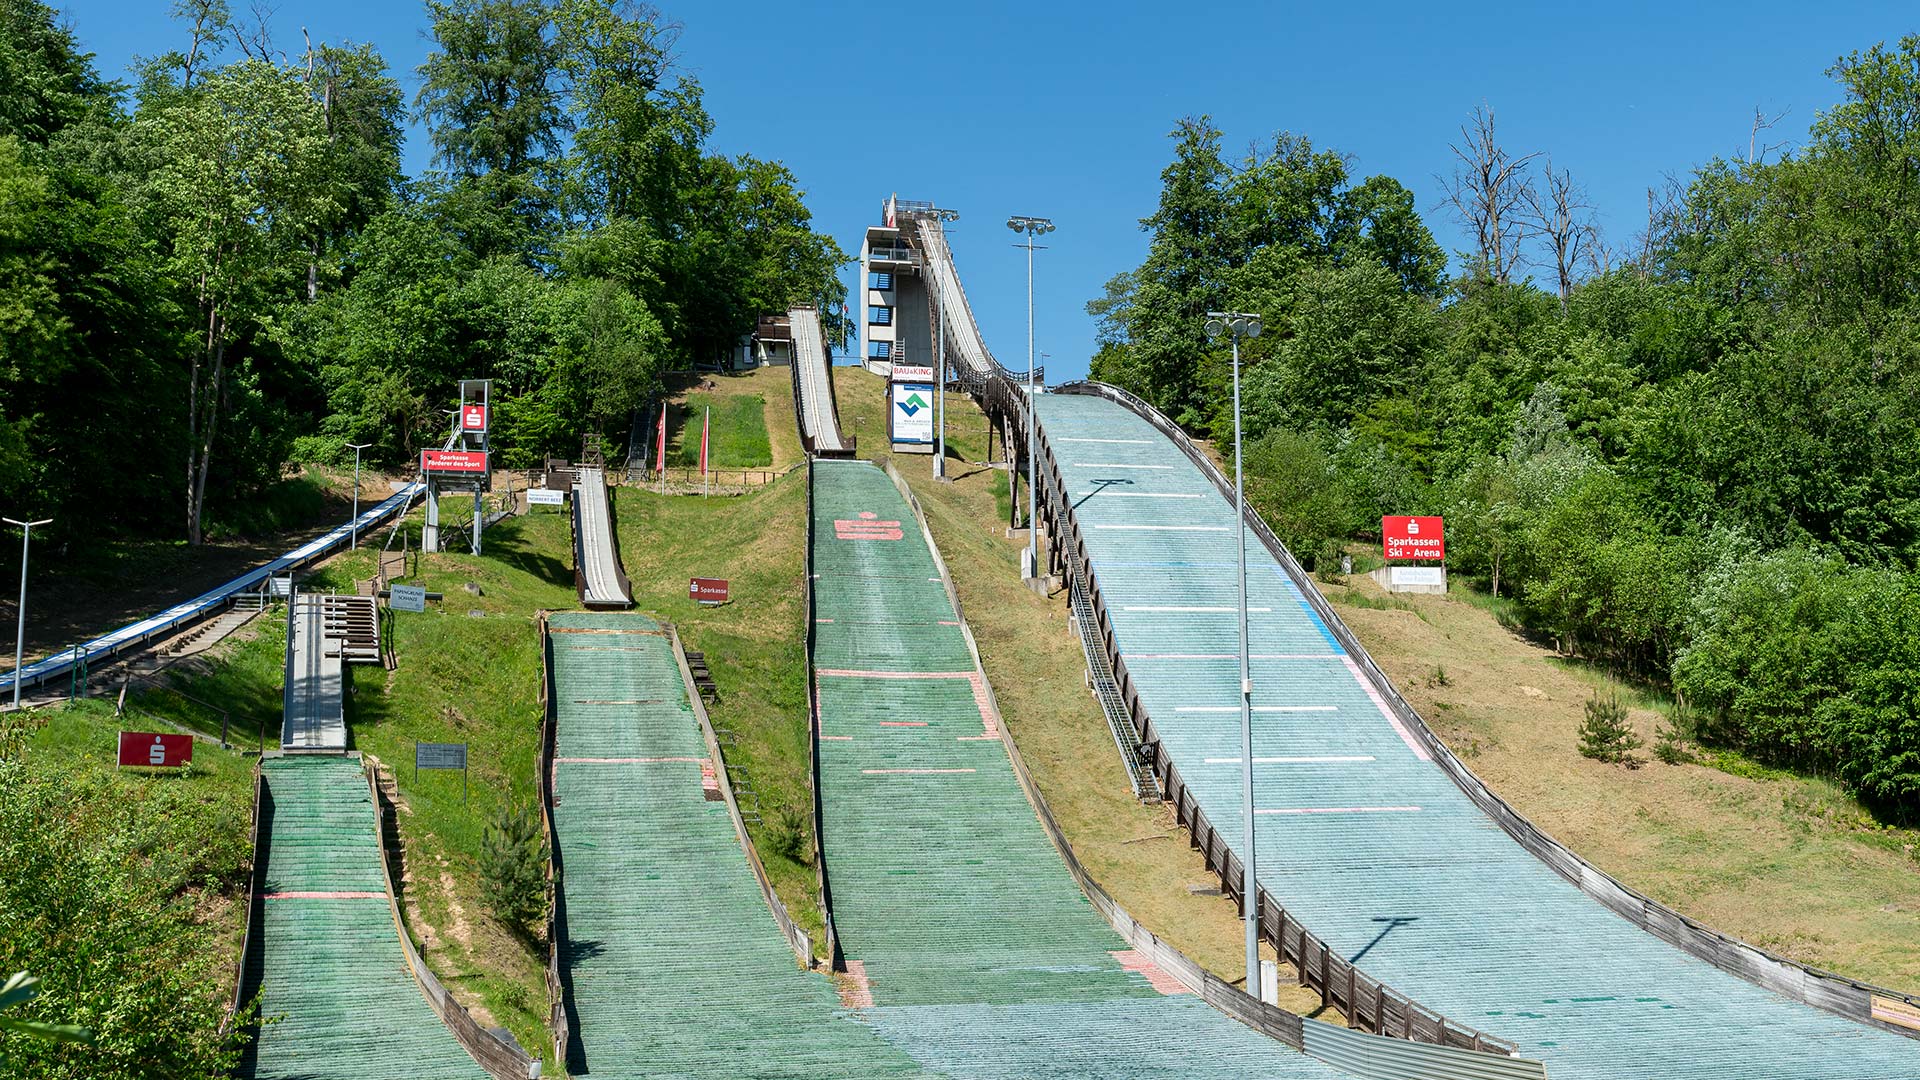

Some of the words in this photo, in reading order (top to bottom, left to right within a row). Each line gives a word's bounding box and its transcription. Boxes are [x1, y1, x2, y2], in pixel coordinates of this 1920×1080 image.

[1388, 536, 1440, 547] Sparkassen
[1388, 548, 1403, 557] Ski
[1413, 548, 1440, 557] Arena
[700, 586, 727, 594] Sparkasse
